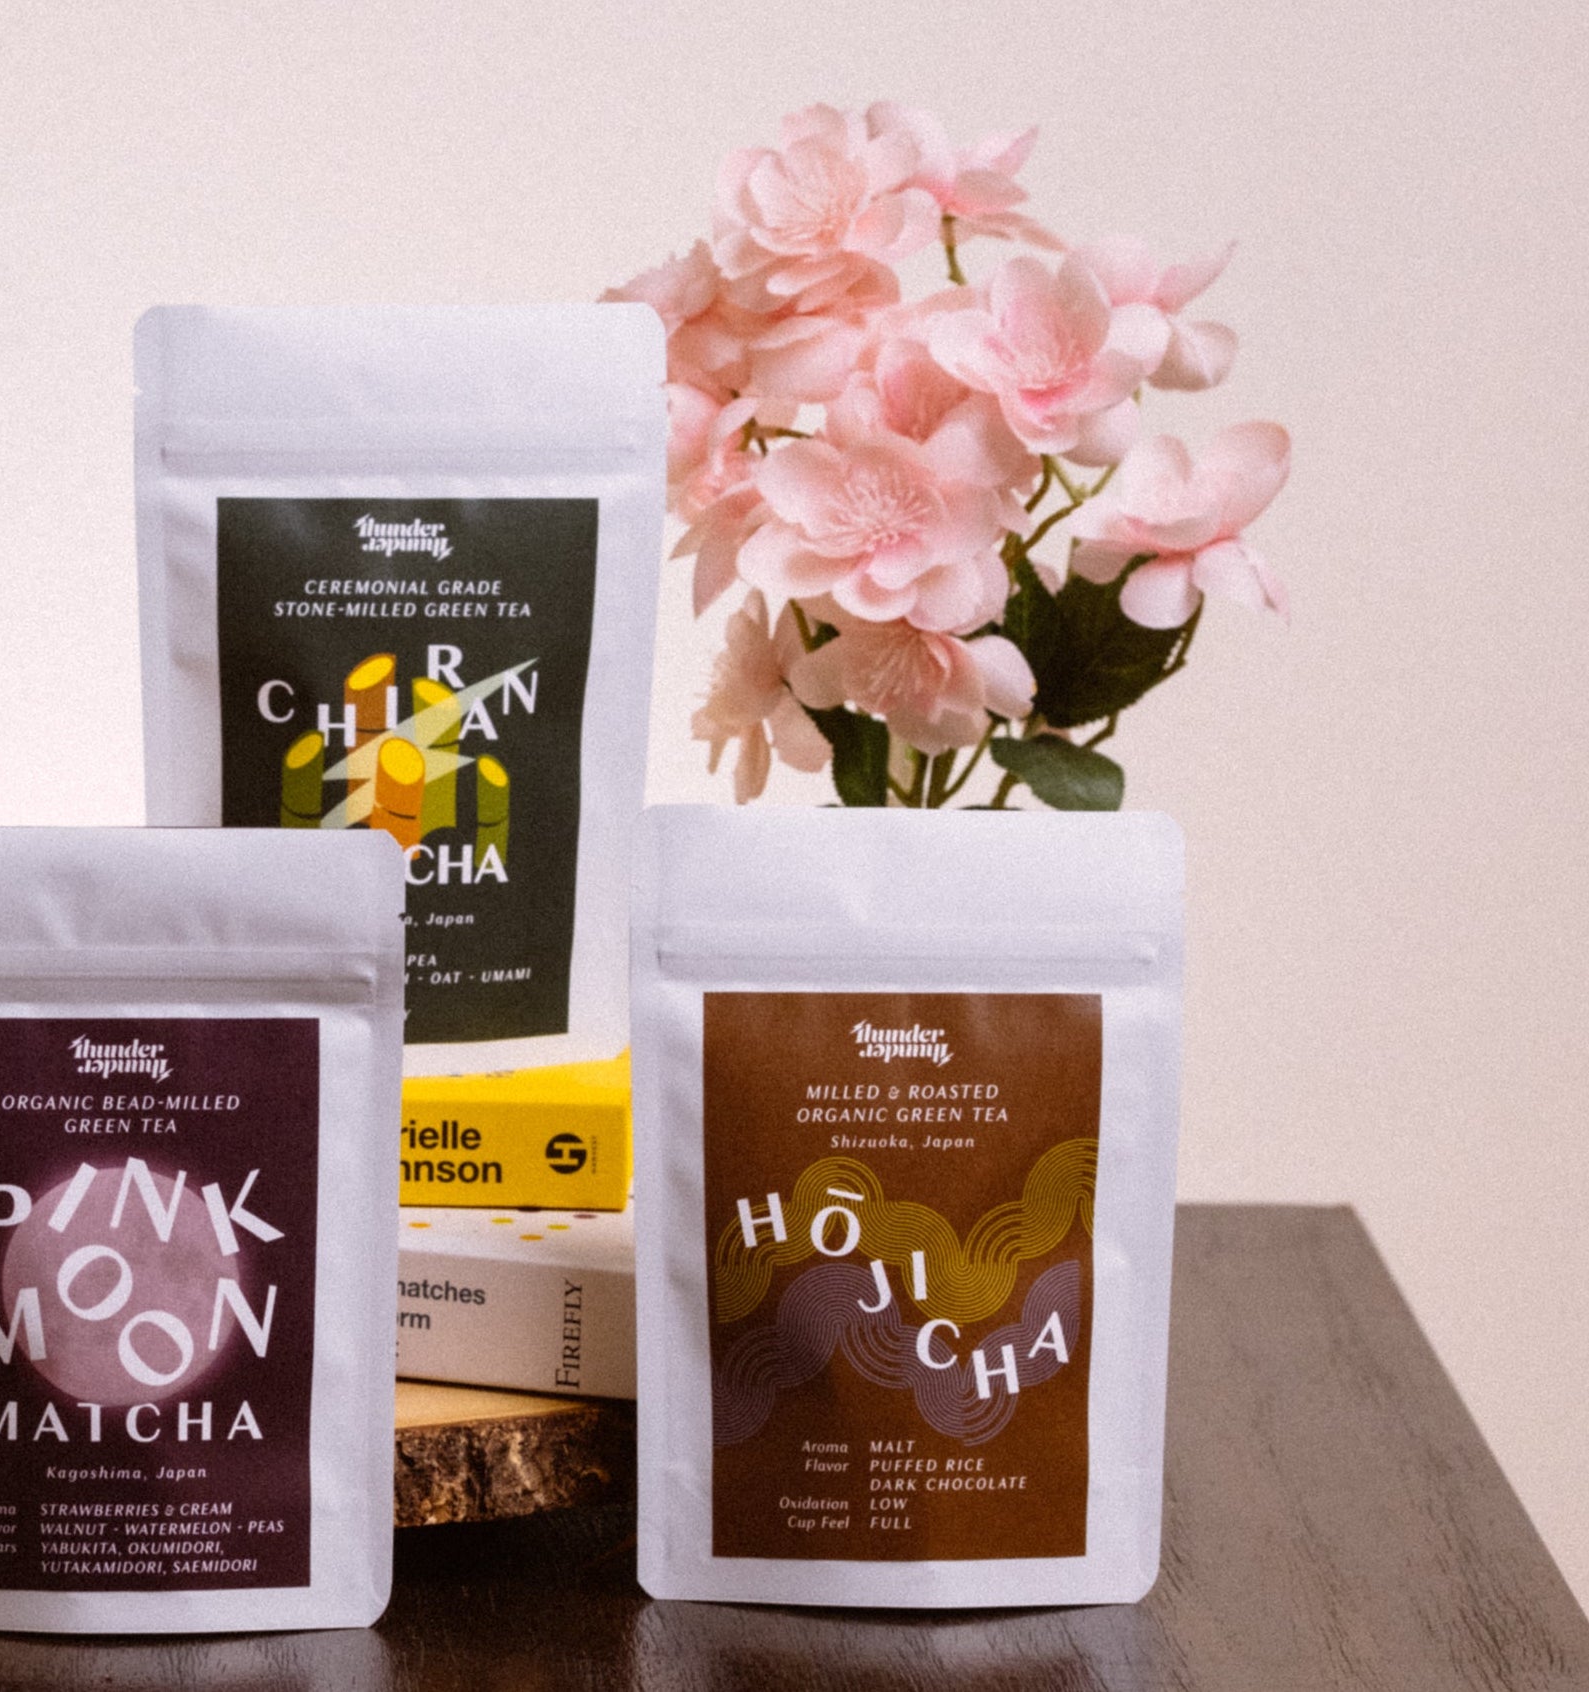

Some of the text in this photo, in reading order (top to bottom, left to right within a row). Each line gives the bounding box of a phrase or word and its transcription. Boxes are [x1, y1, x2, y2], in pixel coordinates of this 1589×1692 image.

[304, 579, 503, 596] CEREMONIAL GRADE
[273, 601, 533, 618] STONE-MILLED GREEN TEA
[425, 911, 475, 928] Japan
[406, 953, 438, 968] PEA
[429, 971, 462, 986] OAT
[480, 967, 532, 984] UMAMI
[805, 1084, 881, 1101] MILLED
[908, 1083, 1000, 1100] ROASTED
[1, 1095, 241, 1112] ORGANIC BEAD-MILLED
[796, 1106, 1009, 1123] ORGANIC GREEN TEA
[64, 1118, 178, 1135] GREEN TEA
[830, 1134, 975, 1151] Shizuoka, Japan
[396, 1311, 431, 1330] rm
[801, 1440, 916, 1454] Aroma MALT
[46, 1465, 208, 1483] Kagoshima, Japan
[804, 1458, 986, 1473] Flavor PUFFED RICE
[869, 1476, 1028, 1491] DARK CHOCOLATE
[40, 1503, 159, 1518] STRAWBERRIES
[179, 1502, 233, 1517] CREAM
[778, 1496, 909, 1511] Oxidation LOW
[39, 1522, 108, 1536] WALNUT
[124, 1520, 232, 1536] WATERMELON
[247, 1520, 285, 1534] PEAS
[787, 1515, 914, 1531] Cup Feel FULL
[40, 1541, 122, 1557] YABUKITA,
[127, 1540, 225, 1556] OKUMIDORI,
[40, 1558, 259, 1576] YUTAKAMIDORI, SAEMIDORI
